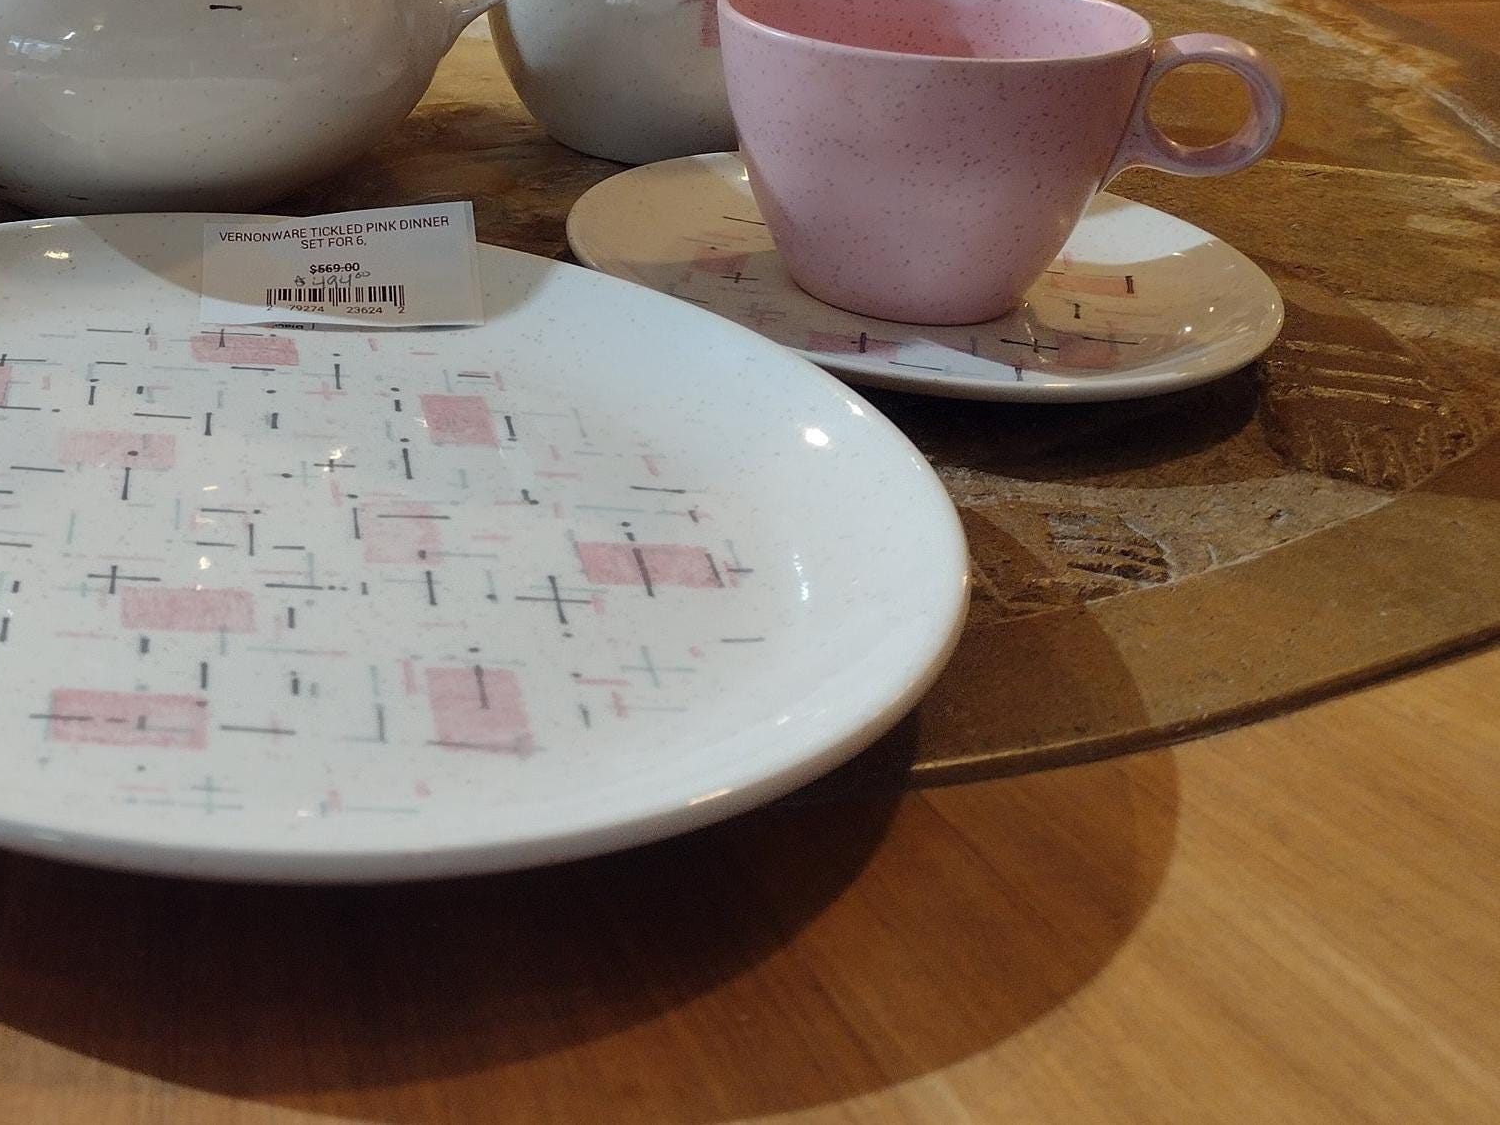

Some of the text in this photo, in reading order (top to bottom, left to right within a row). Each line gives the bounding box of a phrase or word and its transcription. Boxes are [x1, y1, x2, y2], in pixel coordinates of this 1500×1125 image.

[219, 216, 450, 242] VERNONWARE TICKLED PINK DINNER
[300, 238, 325, 250] SET
[328, 236, 354, 248] FOR
[346, 306, 383, 314] 23624
[397, 306, 405, 314] 2
